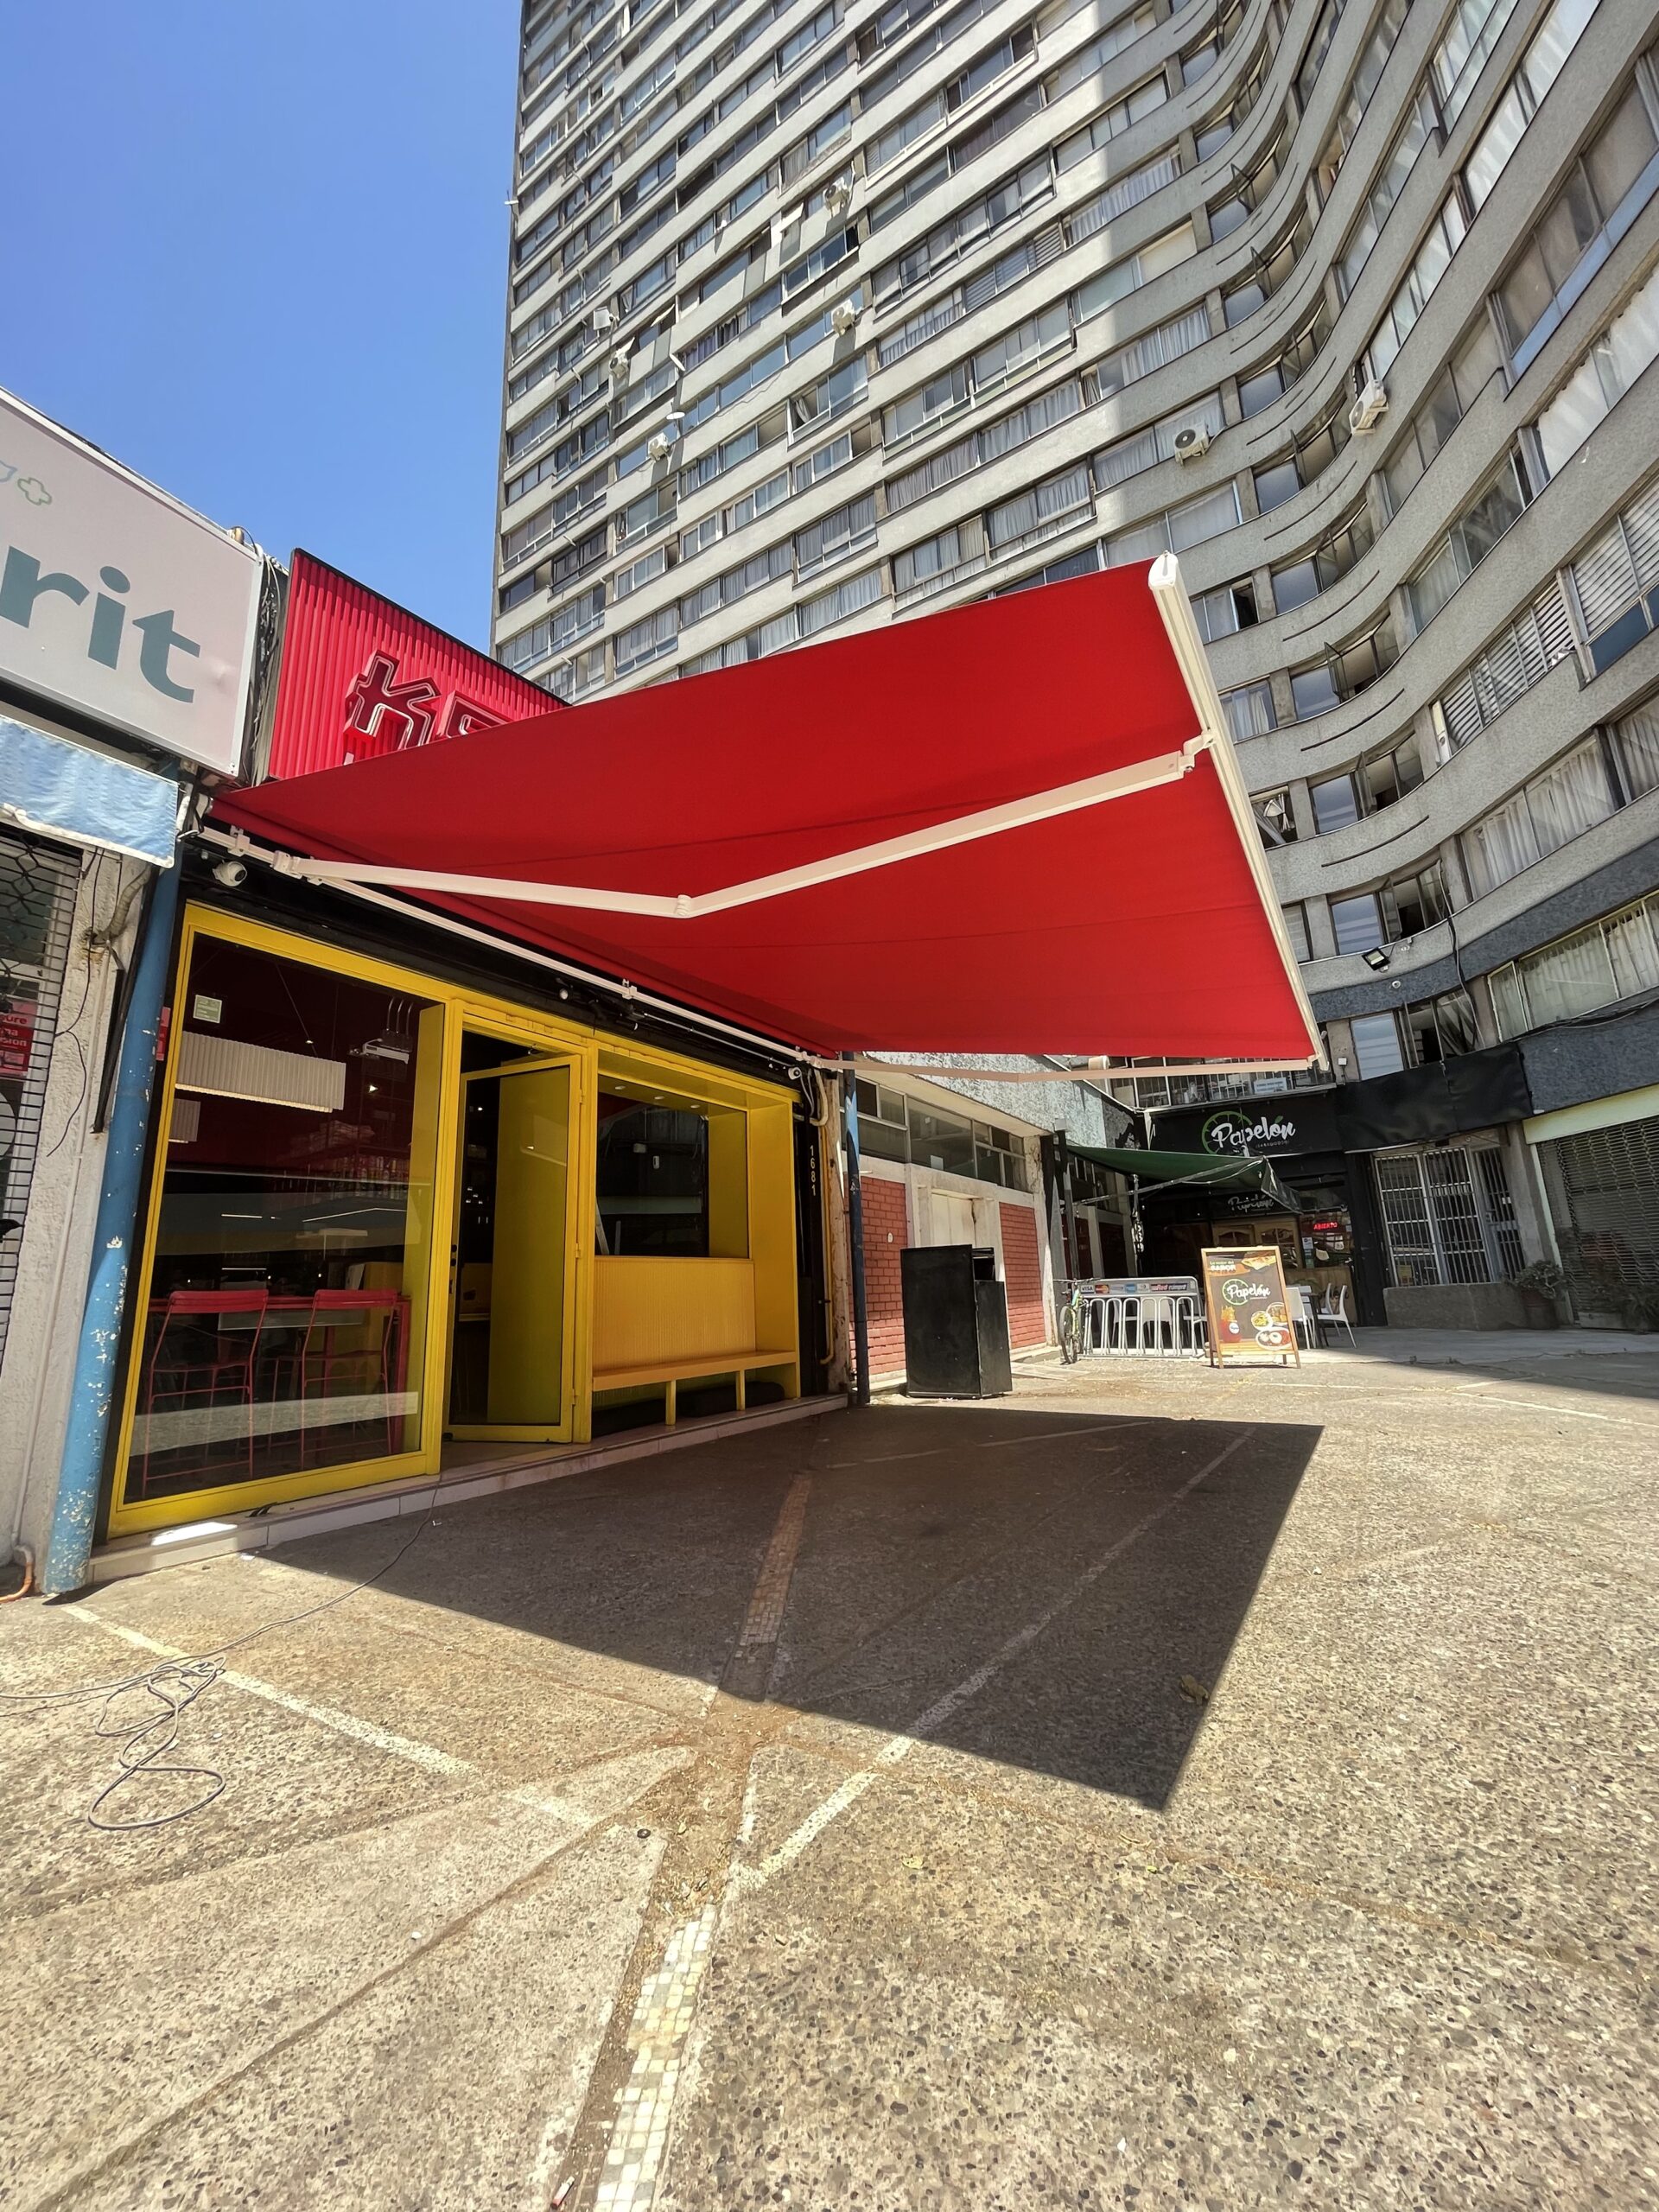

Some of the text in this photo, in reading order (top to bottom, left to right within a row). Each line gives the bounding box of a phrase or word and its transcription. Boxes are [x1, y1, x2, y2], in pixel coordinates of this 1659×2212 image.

[0, 545, 201, 703] rit
[1211, 1116, 1296, 1158] Papelón
[1313, 1222, 1338, 1230] ABIERTO
[1227, 1283, 1271, 1300] Papelón
